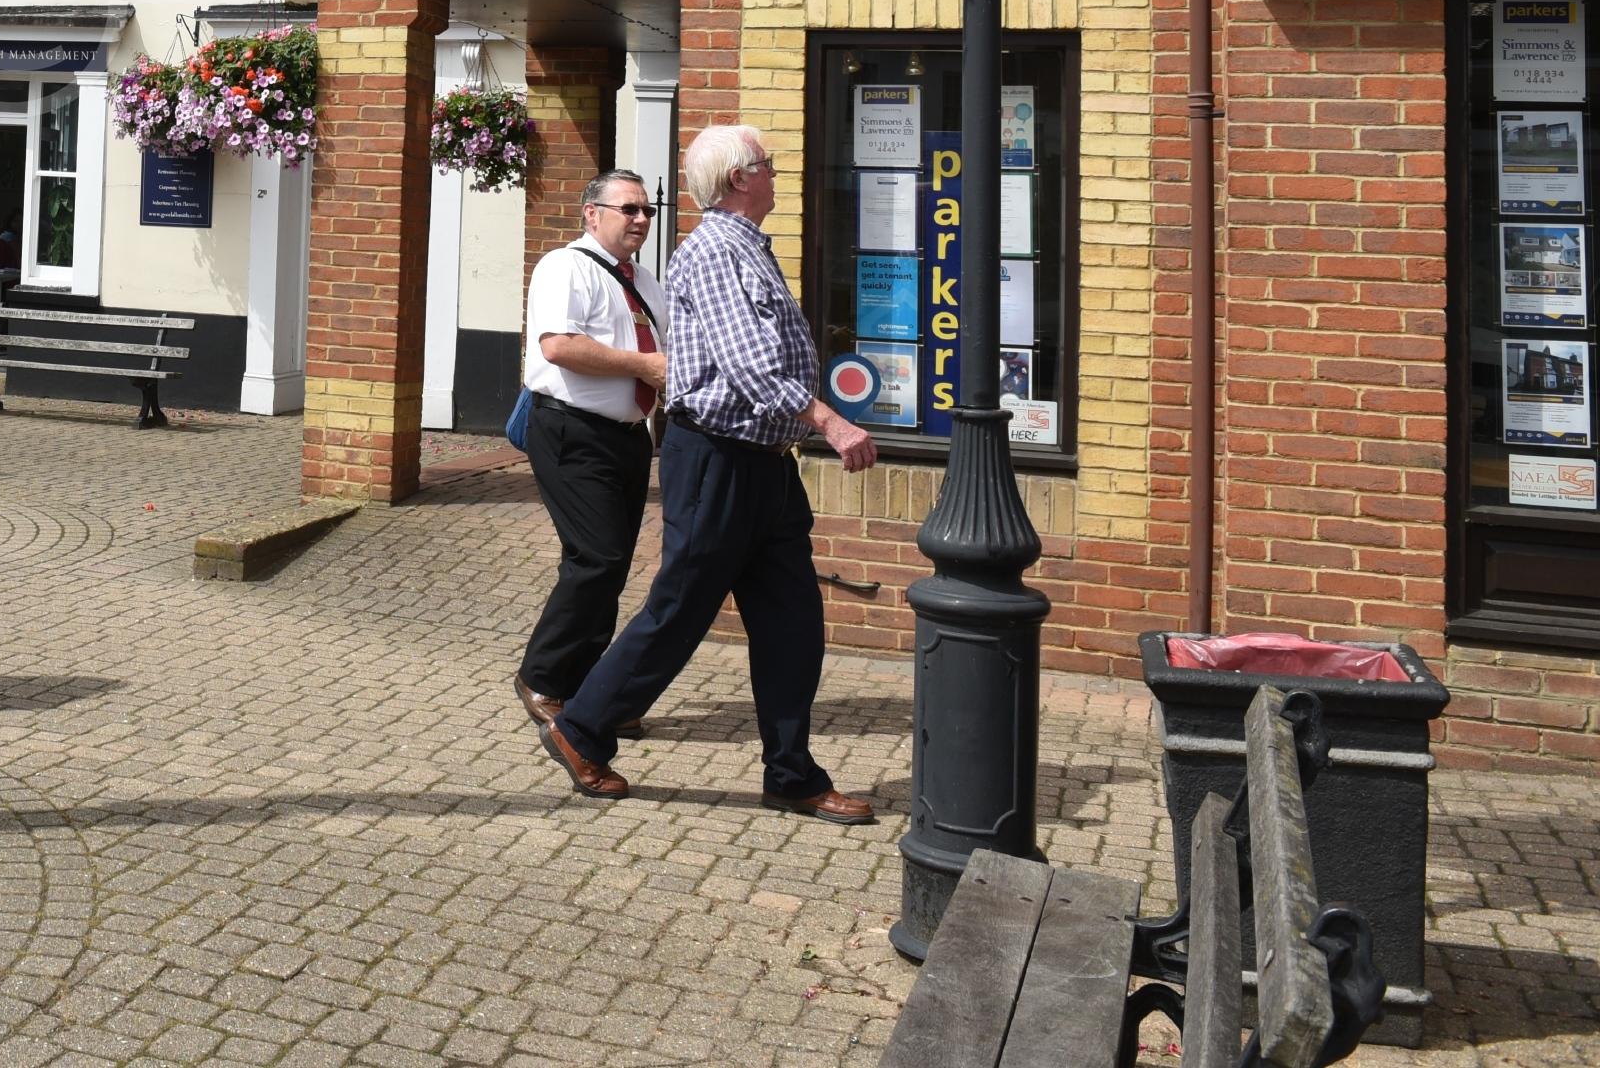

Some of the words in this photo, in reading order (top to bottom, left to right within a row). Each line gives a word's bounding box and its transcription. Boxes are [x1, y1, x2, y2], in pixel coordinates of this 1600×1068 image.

[1506, 3, 1568, 20] parkers
[1502, 38, 1560, 50] Simmons
[1563, 39, 1576, 50] &
[8, 49, 99, 62] MANAGEMENT
[1502, 49, 1560, 61] Lawrence
[1513, 69, 1540, 77] 0118
[1544, 70, 1565, 78] 934
[864, 88, 908, 102] parkers
[860, 116, 903, 126] Simmons
[860, 125, 902, 135] Lawrence
[931, 150, 961, 411] parkers
[1010, 429, 1039, 441] HERE
[1511, 470, 1557, 485] NAEA
